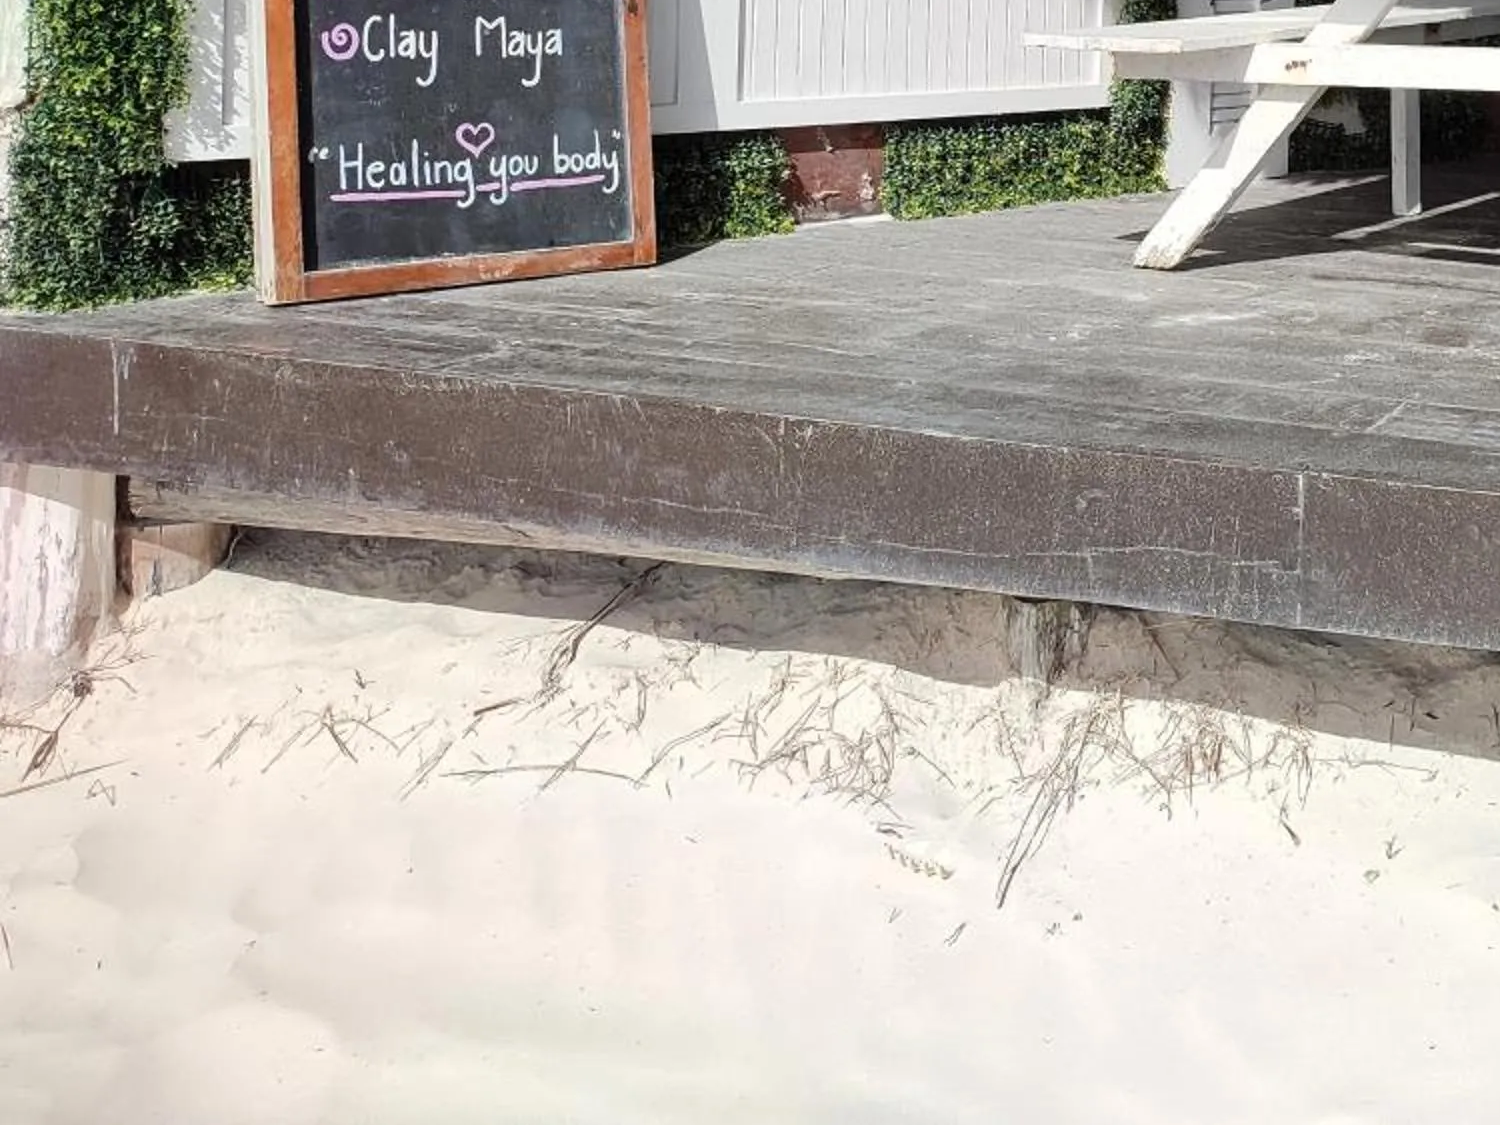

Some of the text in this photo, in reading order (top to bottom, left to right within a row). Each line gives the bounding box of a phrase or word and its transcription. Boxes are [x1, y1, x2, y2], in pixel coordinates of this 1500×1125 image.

[362, 13, 564, 88] Clay Maya
[489, 154, 539, 206] you
